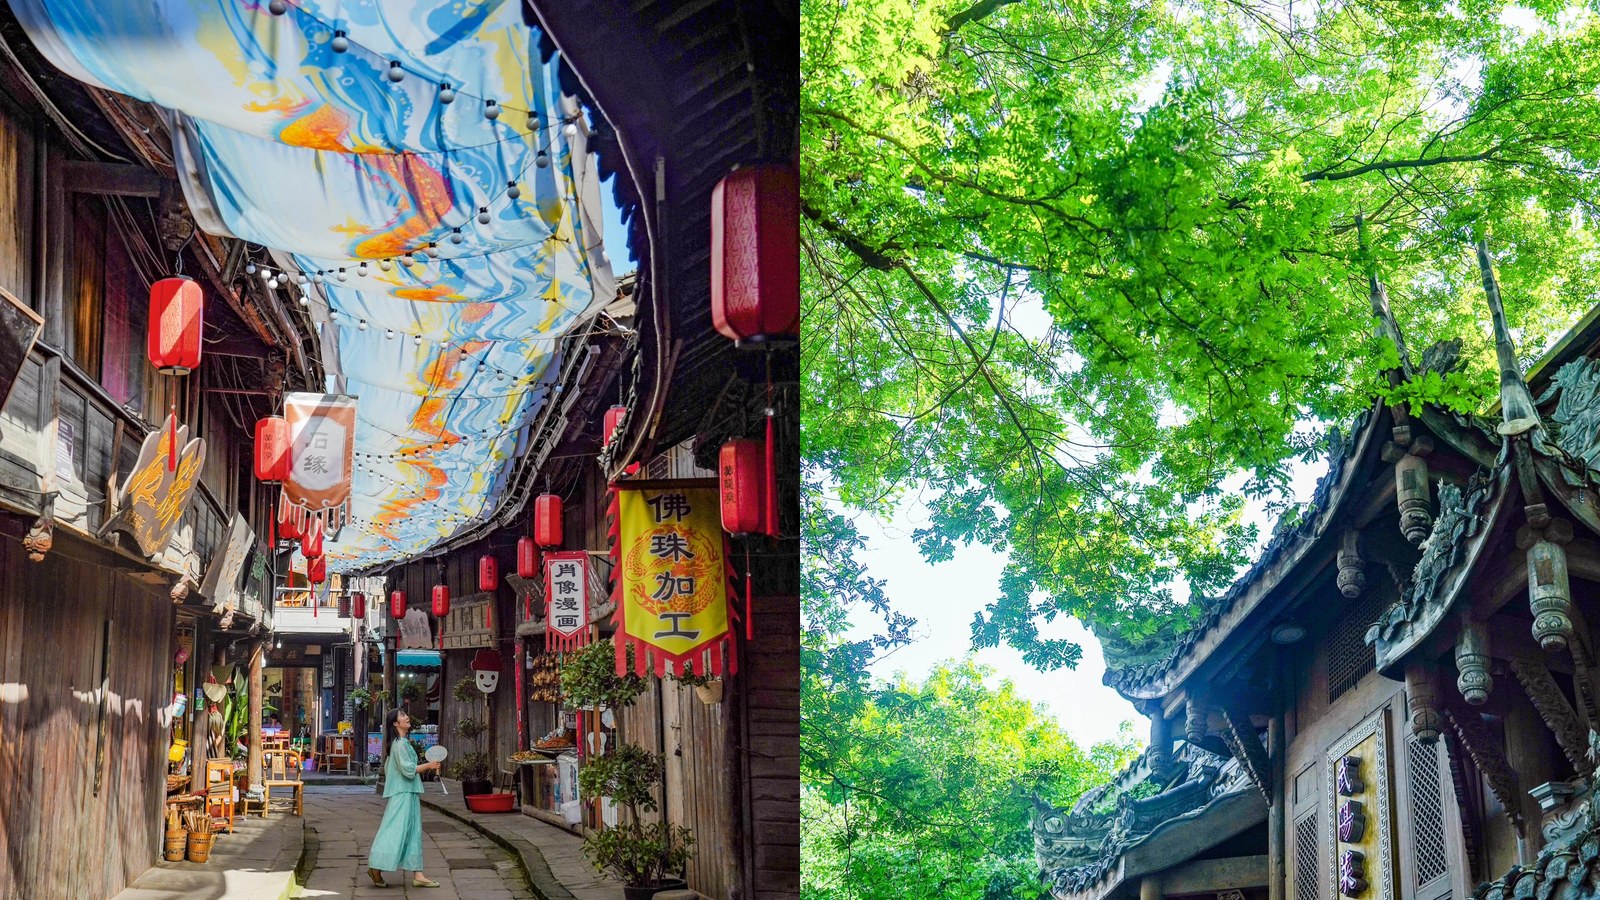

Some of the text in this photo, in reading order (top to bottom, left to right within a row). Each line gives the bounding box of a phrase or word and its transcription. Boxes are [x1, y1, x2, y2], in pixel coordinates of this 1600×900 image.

[304, 431, 329, 475] 石缘
[555, 563, 579, 628] 肖像漫画
[647, 493, 700, 641] 佛珠加工
